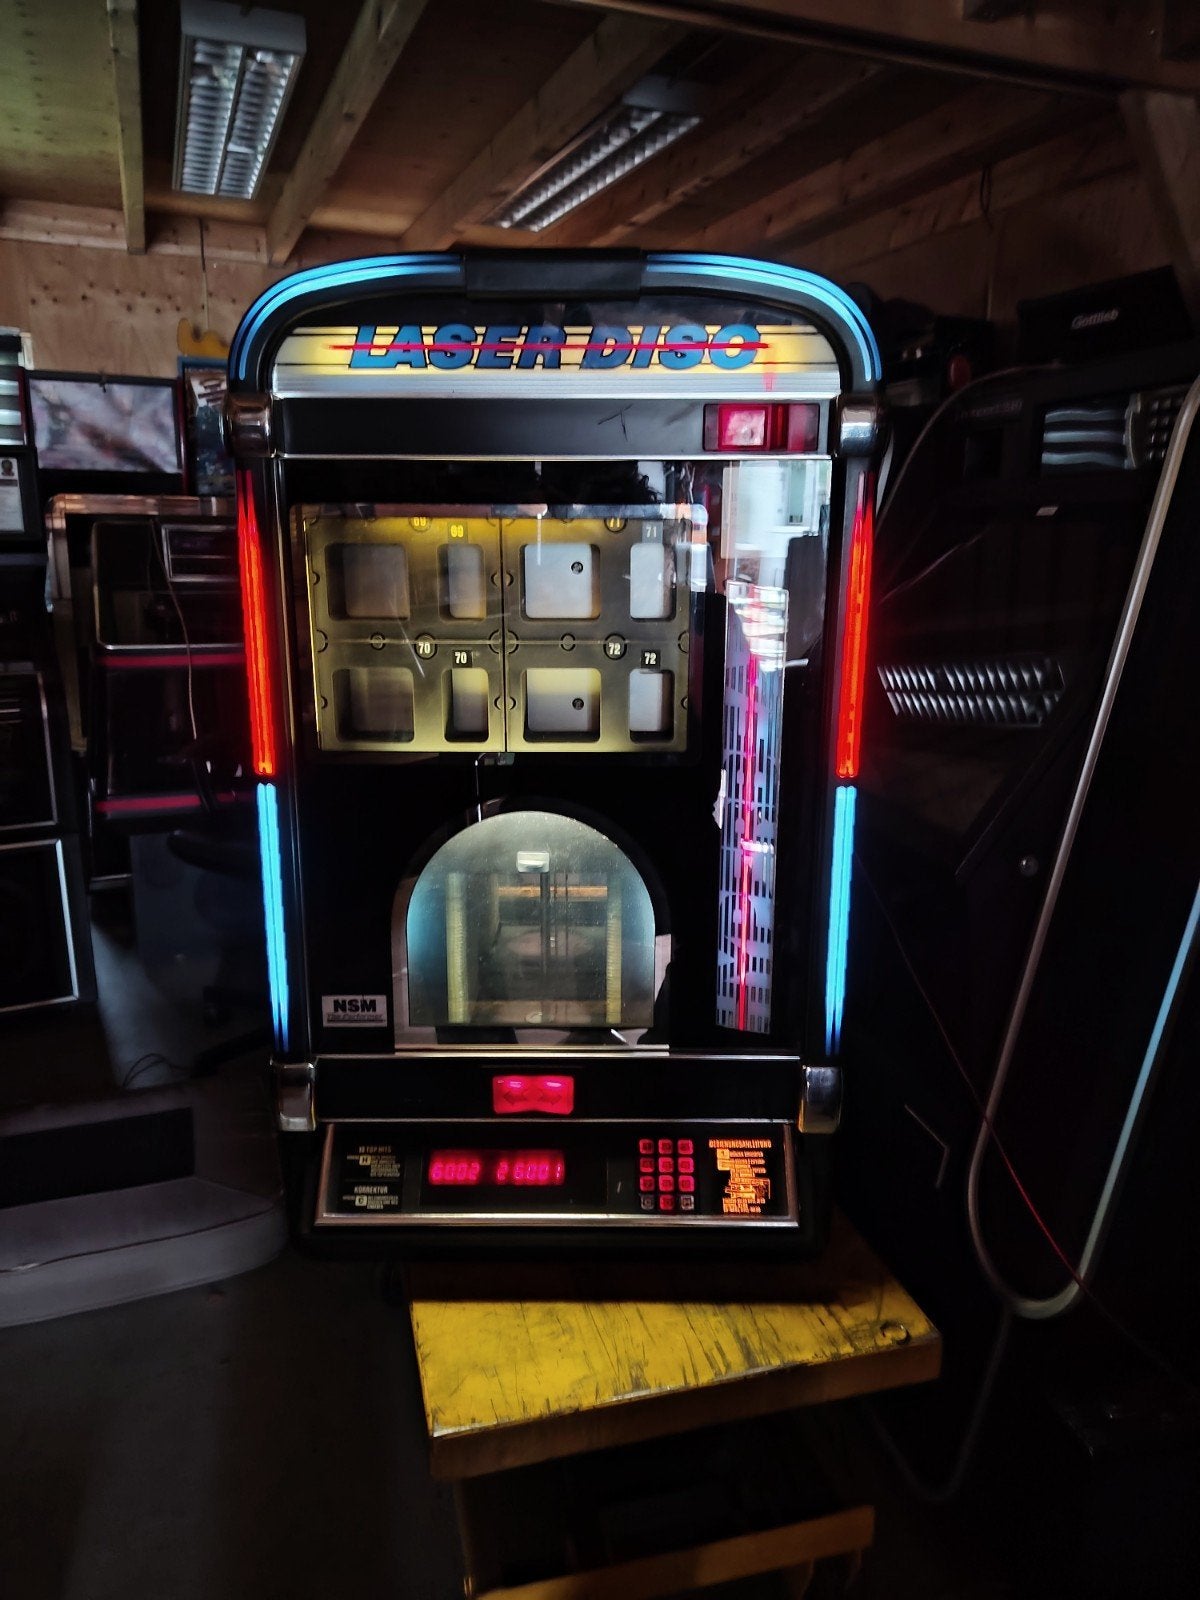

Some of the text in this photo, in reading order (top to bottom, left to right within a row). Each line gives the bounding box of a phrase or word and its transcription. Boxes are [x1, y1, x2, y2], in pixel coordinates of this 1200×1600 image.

[1071, 308, 1120, 330] Gottlieb
[348, 323, 566, 370] LASER
[646, 526, 657, 538] 71
[418, 642, 431, 654] 70
[608, 642, 621, 655] 72
[455, 652, 468, 664] 70
[644, 652, 657, 665] 72
[333, 999, 377, 1013] NSM
